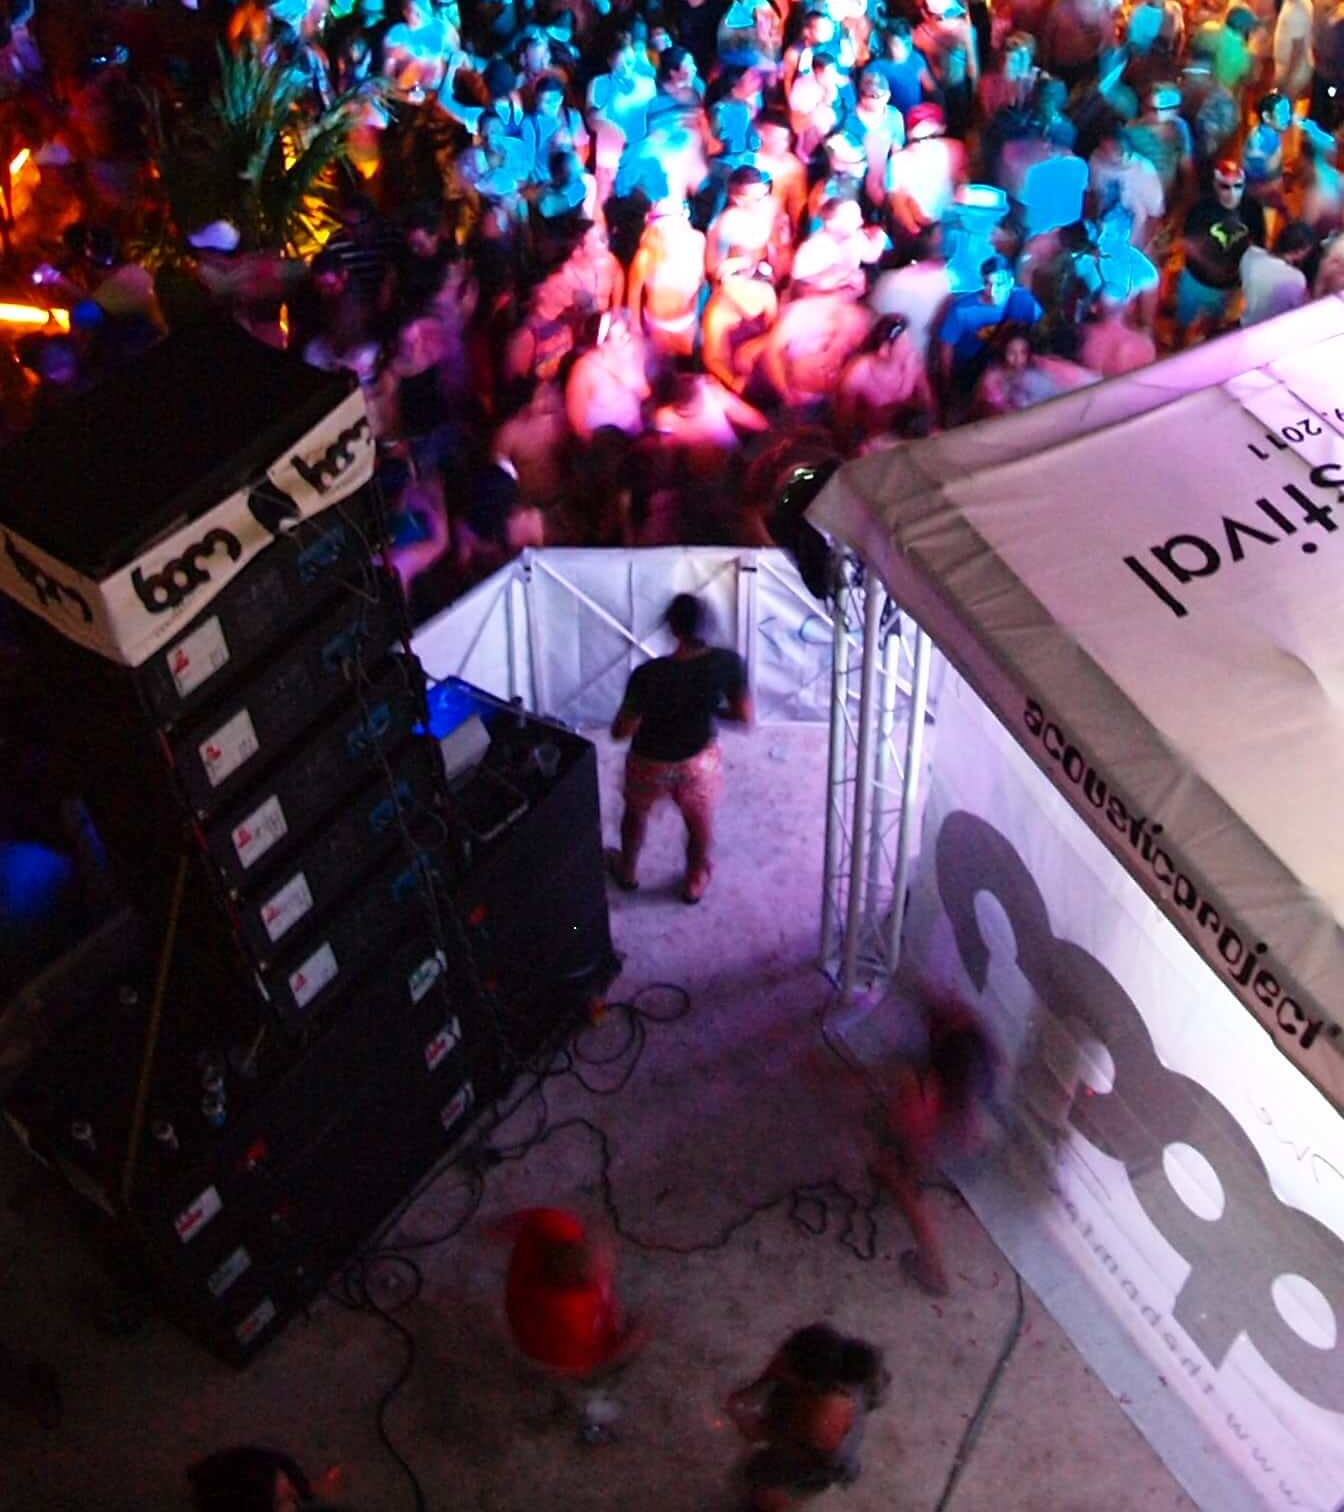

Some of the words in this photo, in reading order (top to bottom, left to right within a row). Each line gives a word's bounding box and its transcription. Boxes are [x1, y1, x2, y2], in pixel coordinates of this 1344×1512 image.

[1248, 419, 1323, 461] 2011
[130, 527, 243, 615] bpm
[1024, 695, 1328, 1052] acousticproject
